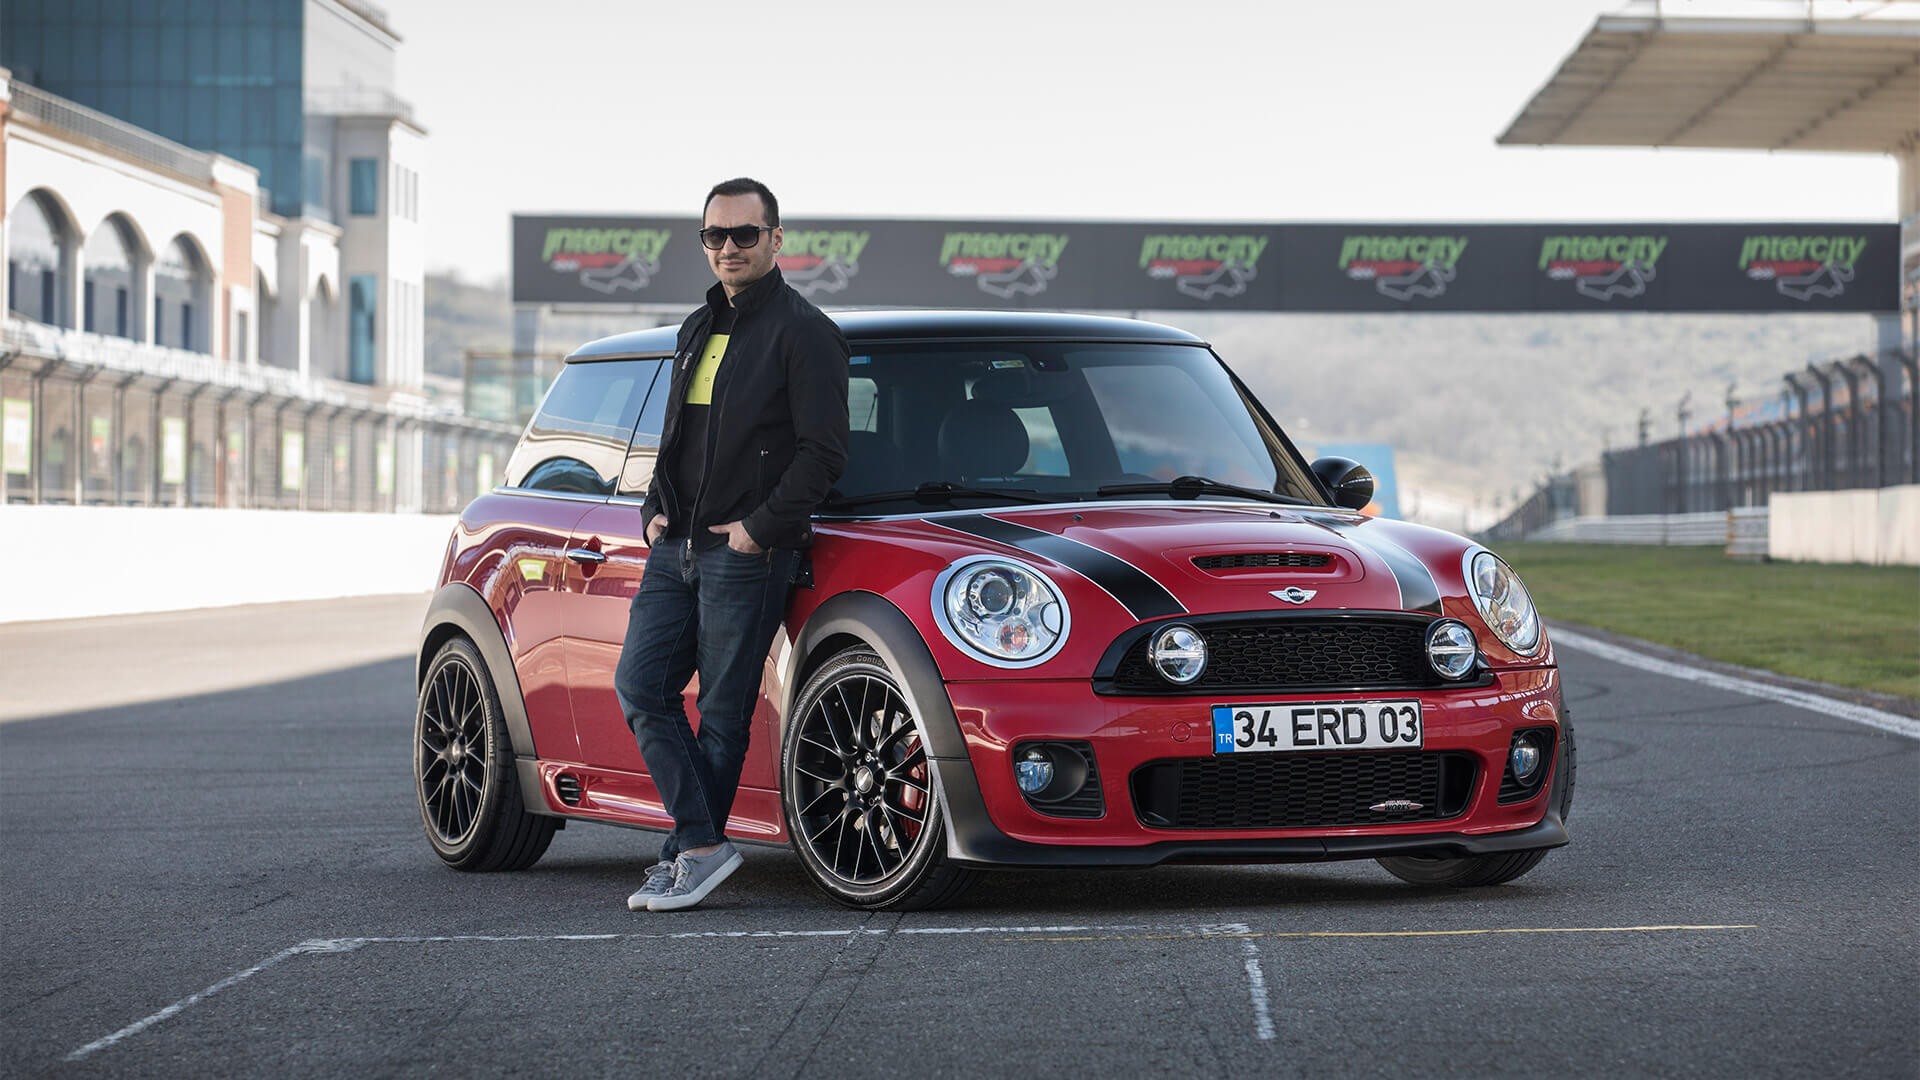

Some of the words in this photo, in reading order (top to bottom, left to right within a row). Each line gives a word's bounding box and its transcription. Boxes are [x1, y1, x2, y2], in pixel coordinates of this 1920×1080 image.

[1218, 733, 1233, 744] TR
[1234, 710, 1278, 748] 34
[1291, 706, 1367, 746] ERD
[1378, 705, 1417, 743] 03
